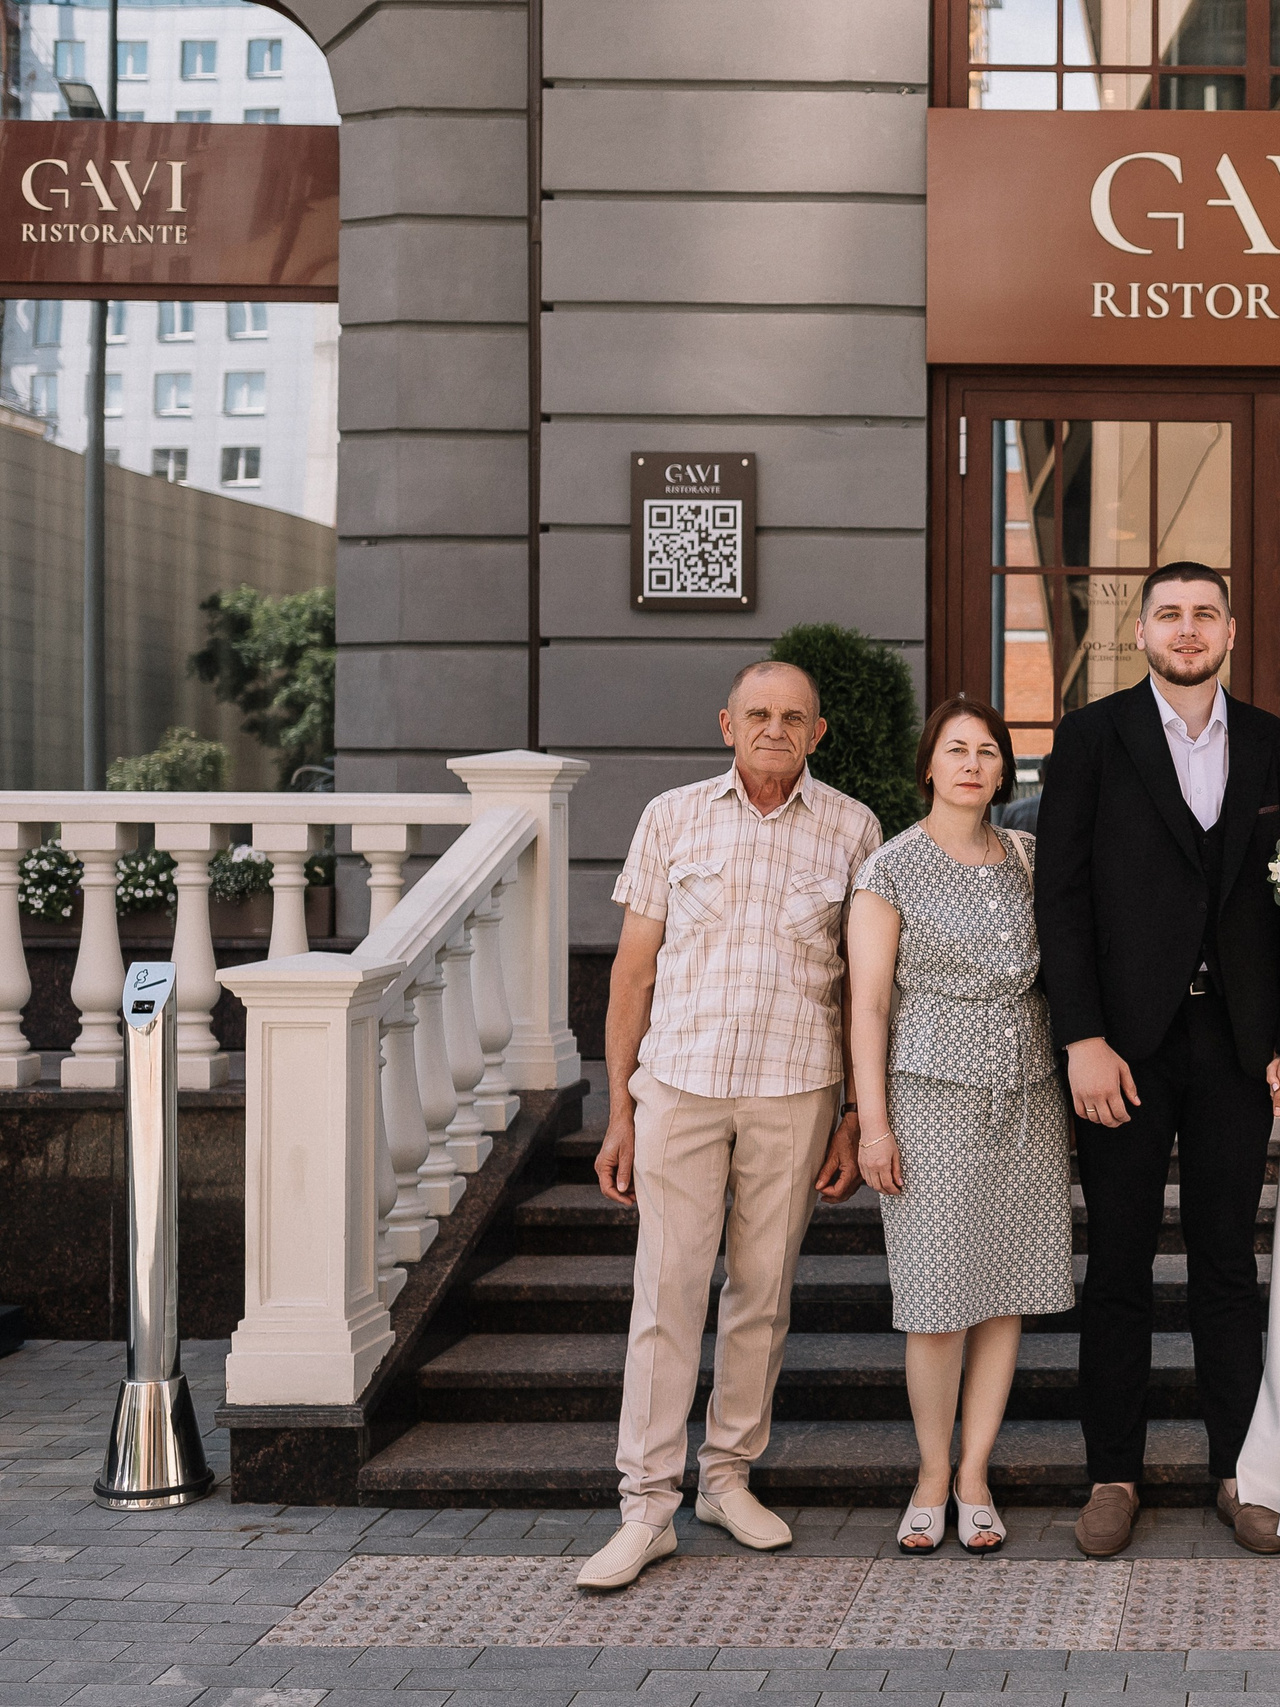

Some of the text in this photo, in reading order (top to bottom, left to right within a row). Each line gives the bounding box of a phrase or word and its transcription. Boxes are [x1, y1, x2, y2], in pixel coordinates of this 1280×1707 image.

[20, 158, 188, 213] GAVI
[21, 222, 189, 246] RISTORANTE
[664, 463, 721, 484] GAVI
[665, 484, 721, 494] RISTORANTE
